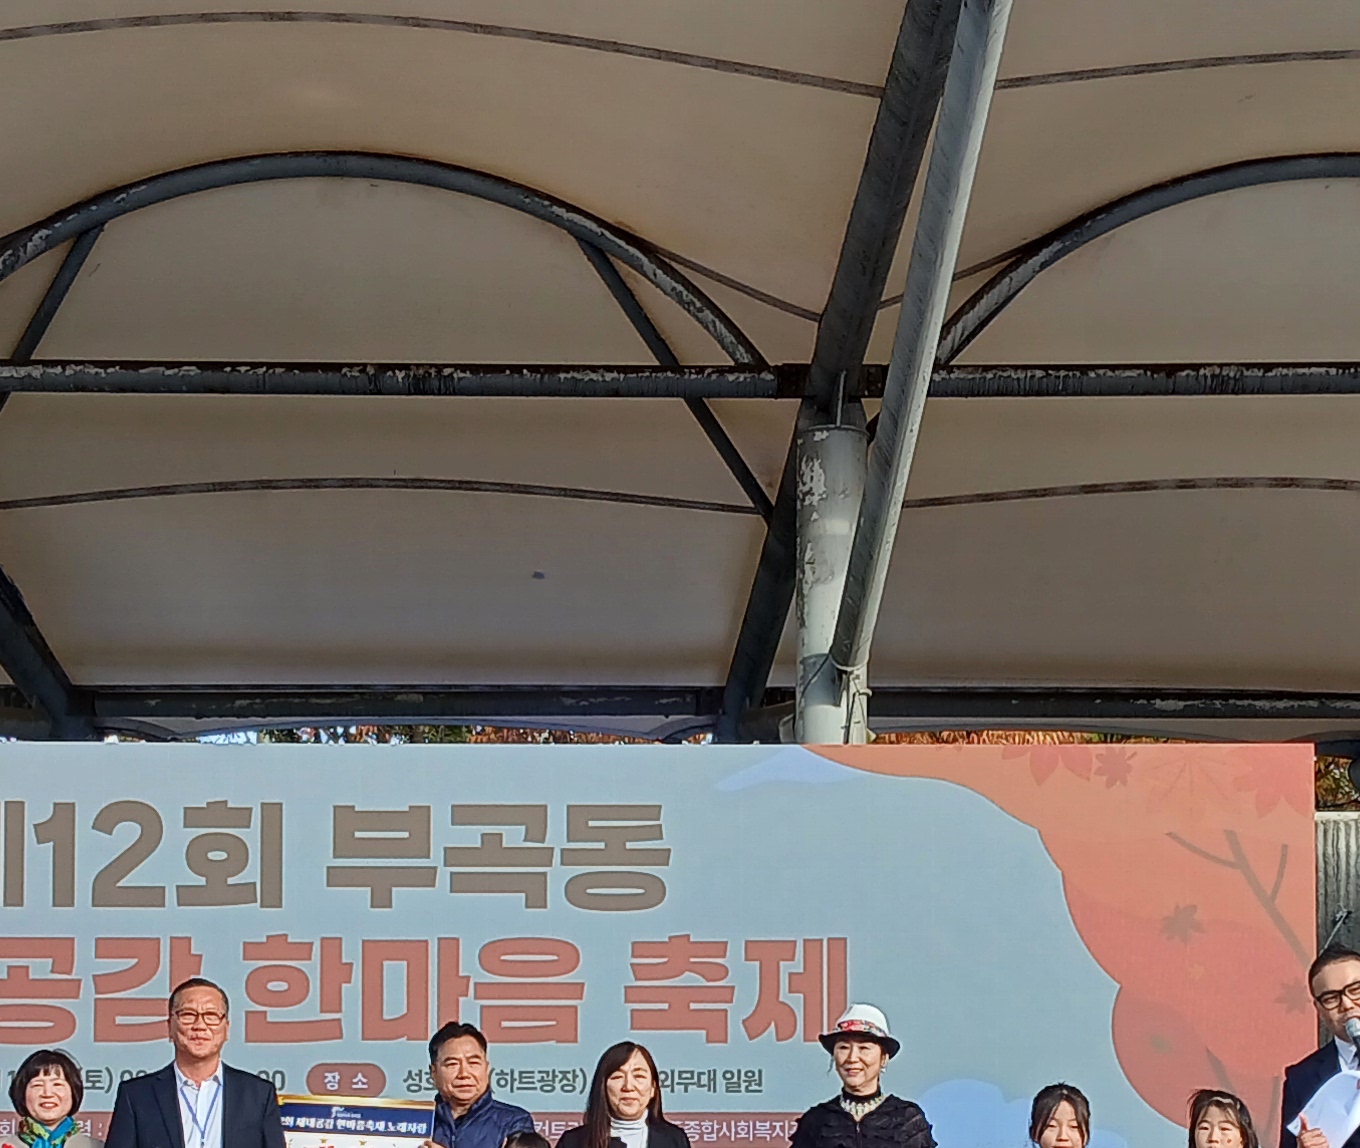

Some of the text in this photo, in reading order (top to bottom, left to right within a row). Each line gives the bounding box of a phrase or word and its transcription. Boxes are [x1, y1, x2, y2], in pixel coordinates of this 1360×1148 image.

[325, 801, 671, 912] 부곡동
[242, 933, 585, 1045] 한마음
[624, 933, 850, 1045] 축제
[657, 1069, 717, 1093] 외무대
[722, 1069, 763, 1093] 일원
